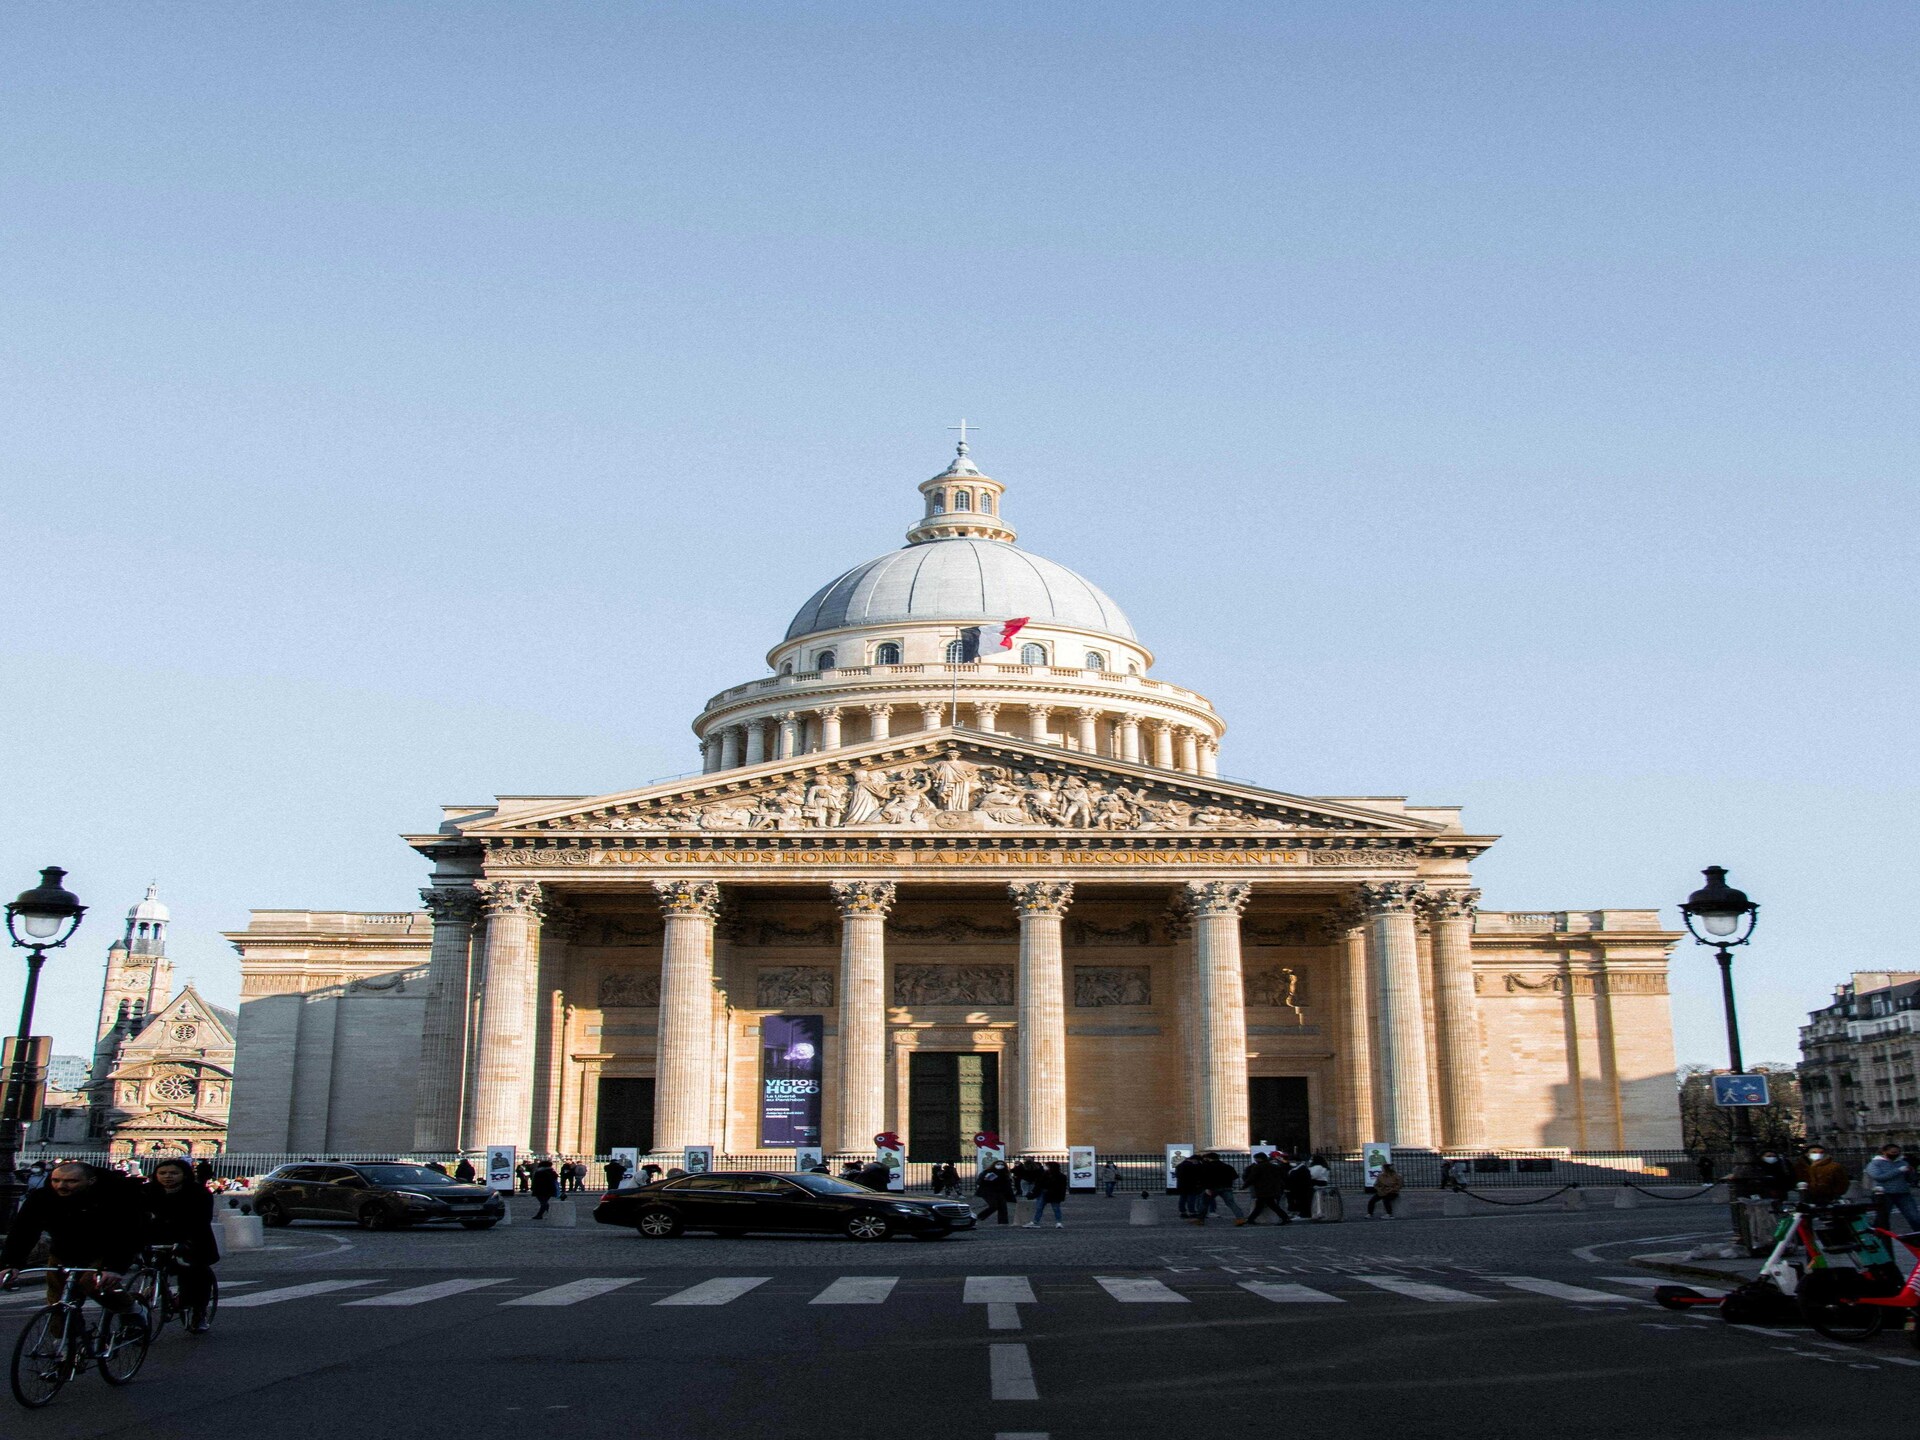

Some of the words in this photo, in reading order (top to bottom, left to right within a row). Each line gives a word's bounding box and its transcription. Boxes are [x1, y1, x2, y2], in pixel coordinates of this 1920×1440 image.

[600, 850, 658, 864] AUX
[664, 850, 774, 864] GRANDS
[781, 850, 897, 864] HOMMES
[914, 850, 948, 864] LA
[955, 850, 1052, 864] PATRIE
[1061, 850, 1298, 864] RECONNAISSANTE
[766, 1086, 819, 1094] HUGO
[1165, 1265, 1513, 1274] PRIORITE
